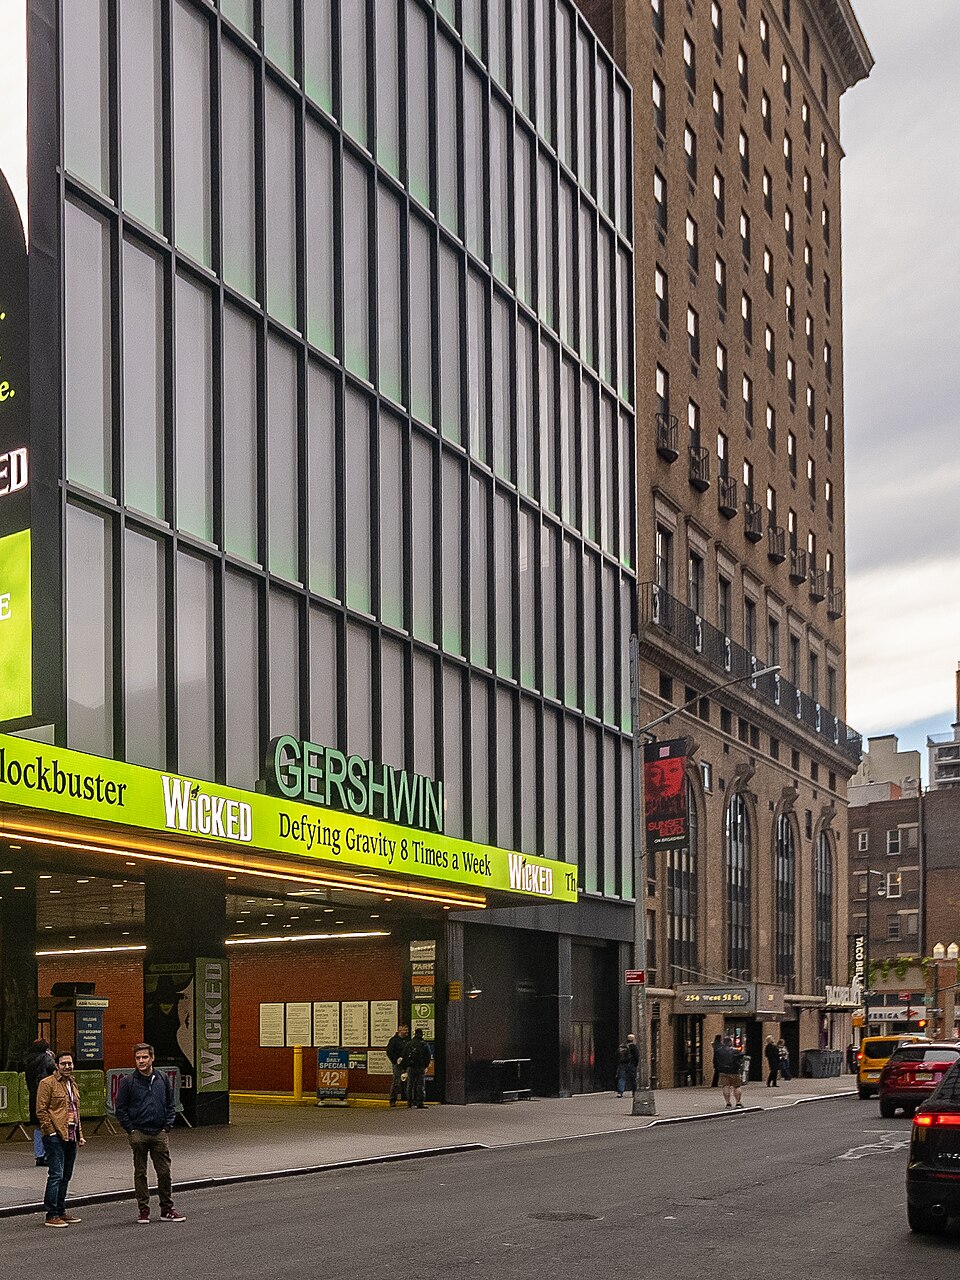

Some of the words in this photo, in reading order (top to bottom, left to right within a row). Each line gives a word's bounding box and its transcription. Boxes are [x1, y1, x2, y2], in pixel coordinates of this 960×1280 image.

[272, 734, 443, 832] GERSHWIN
[279, 812, 342, 855] Defying
[345, 827, 396, 865] Gravity
[400, 838, 409, 861] 8
[412, 840, 449, 869] Times
[452, 856, 459, 871] a
[462, 851, 492, 877] Week
[648, 818, 685, 832] SUNSET
[855, 936, 864, 960] TACO
